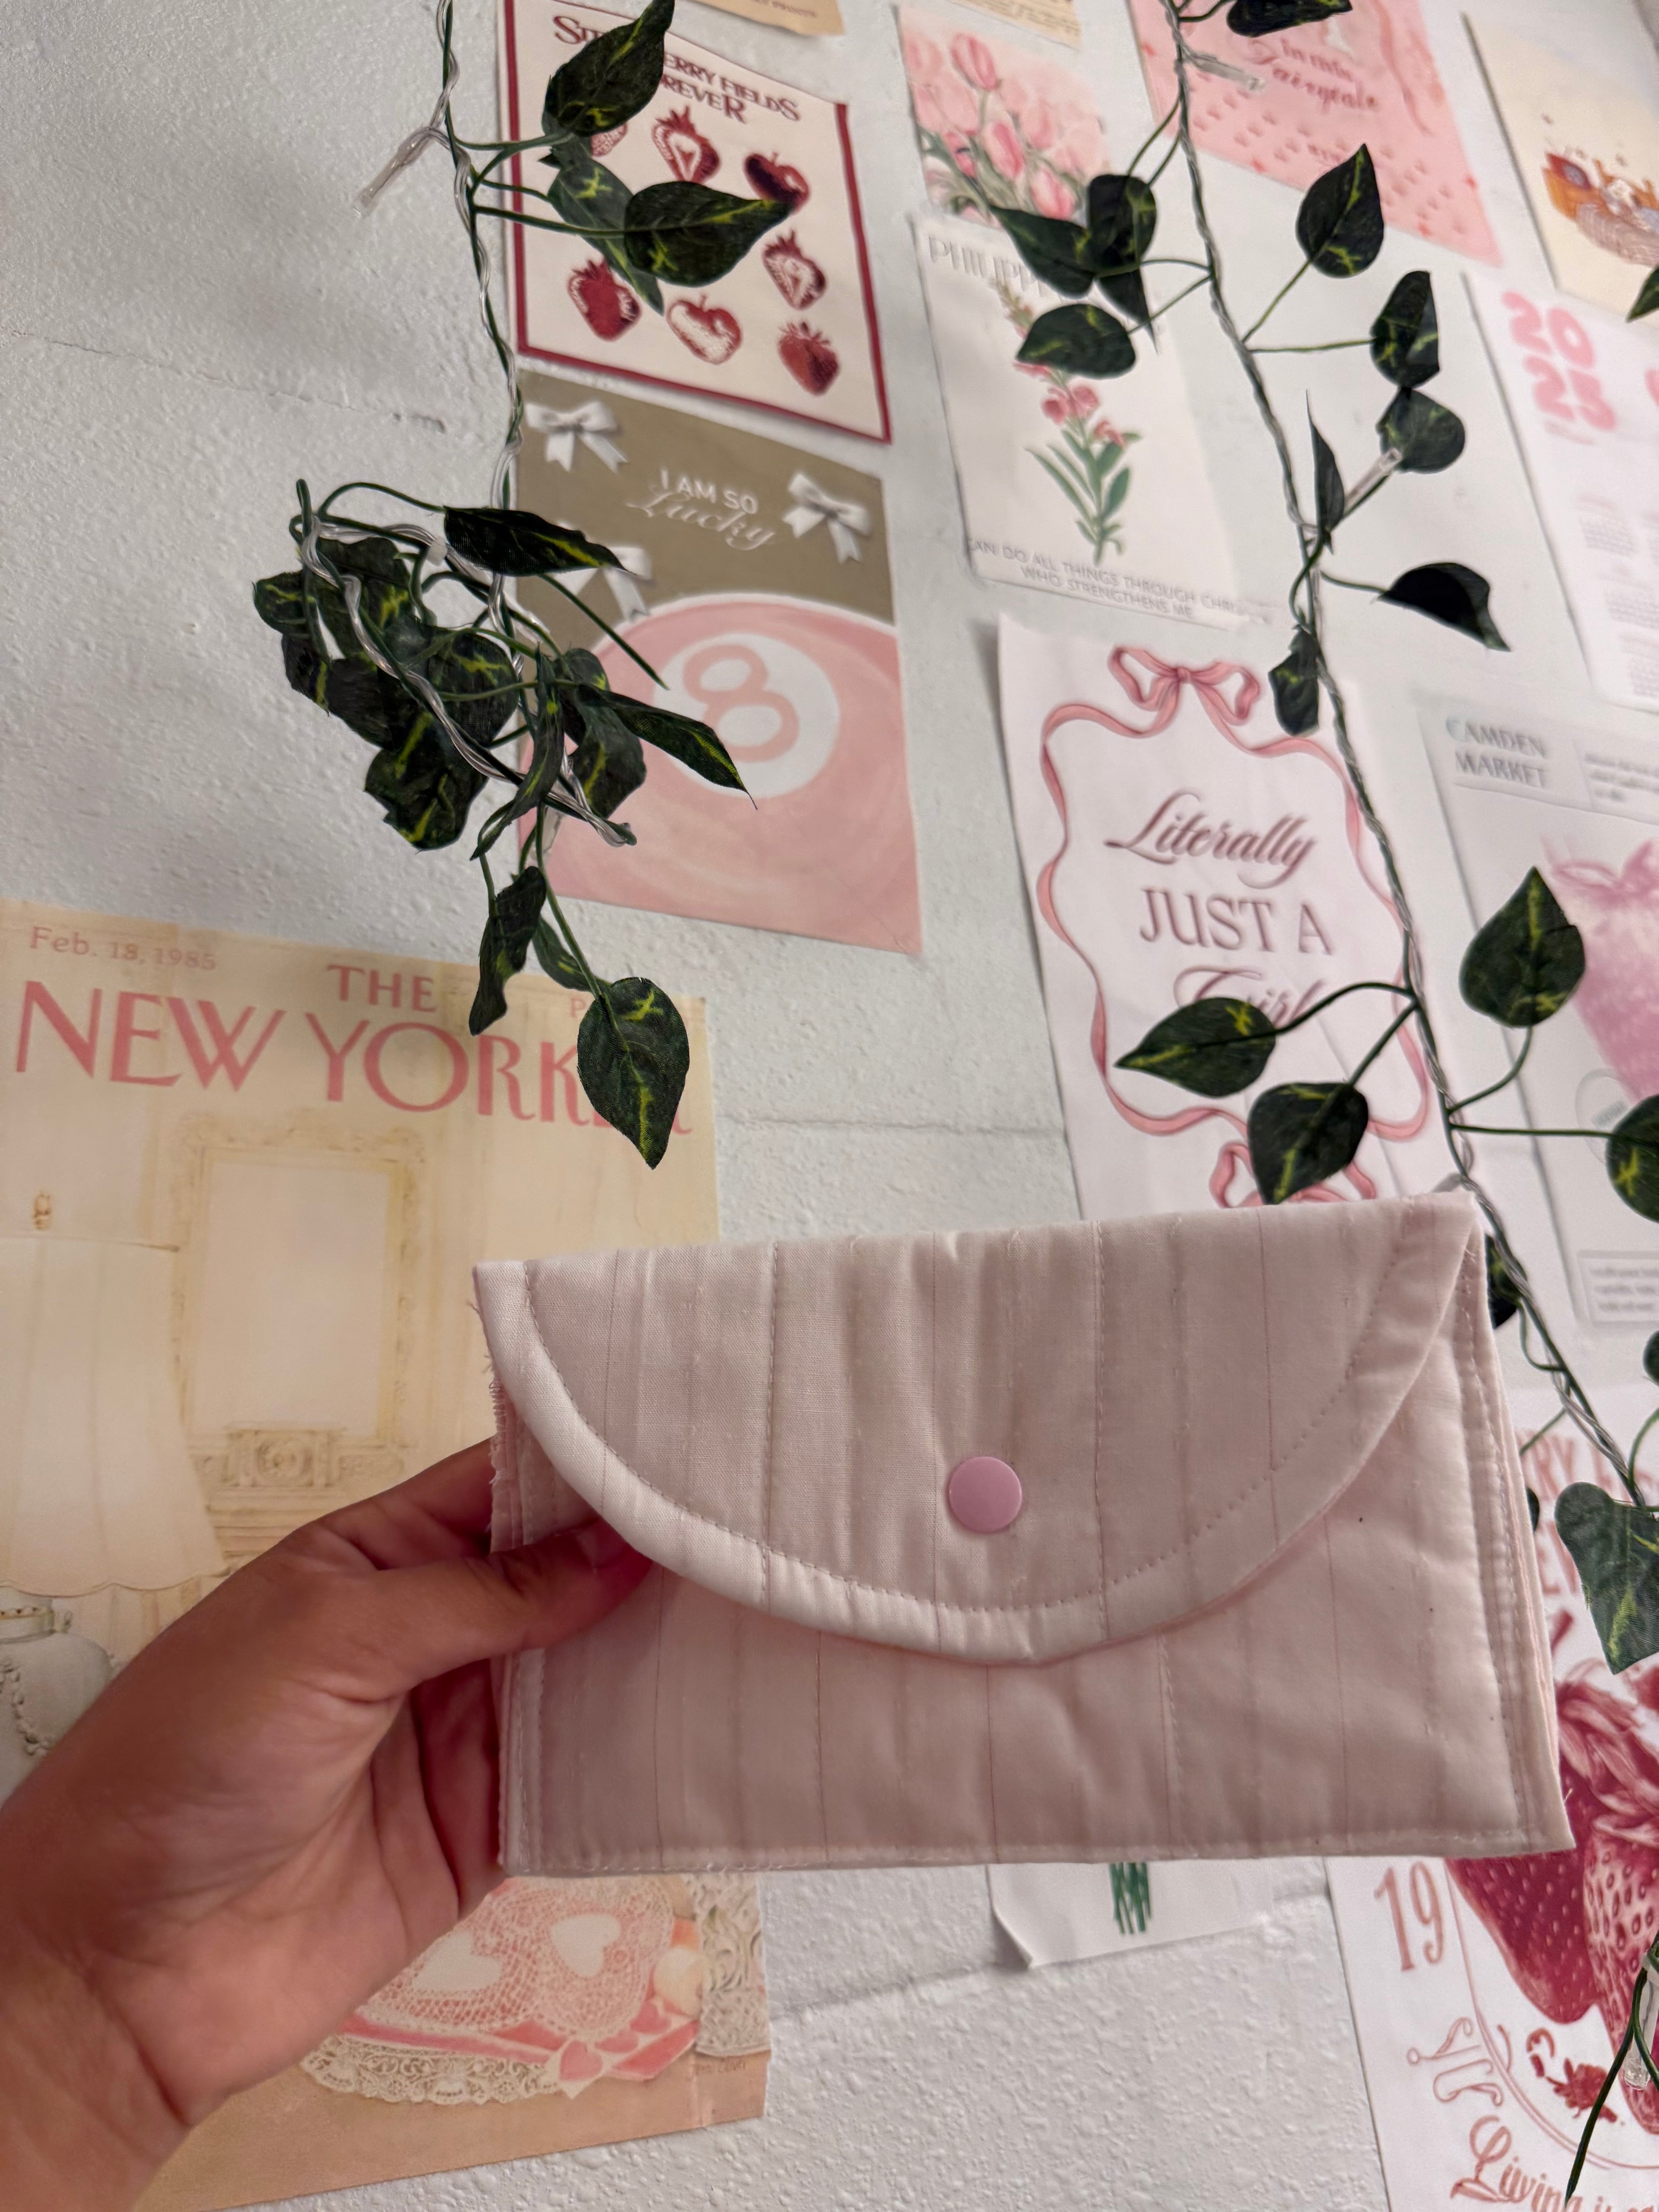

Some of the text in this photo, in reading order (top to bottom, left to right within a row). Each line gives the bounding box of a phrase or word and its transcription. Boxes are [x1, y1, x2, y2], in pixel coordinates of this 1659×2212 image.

[553, 16, 800, 122] STERRY FIELDS
[660, 73, 747, 124] REVER
[1501, 289, 1596, 369] 20
[625, 482, 776, 551] Lucky
[660, 467, 760, 515] I AM SO
[1001, 545, 1030, 563] DO
[1032, 553, 1057, 572] ALL
[1061, 561, 1121, 586] THINGS
[1122, 575, 1196, 605] THROUGH
[1020, 565, 1064, 588] WHO
[1066, 578, 1170, 614] STRENGTHENS
[682, 643, 801, 762] 8
[1453, 750, 1549, 789] MARKET
[1103, 787, 1316, 889] Literally
[29, 925, 97, 957] Feb.
[154, 947, 217, 971] 1985
[1139, 884, 1333, 955] JUST A
[327, 963, 437, 1013] THE
[16, 980, 692, 1135] NEW YORK
[1374, 1860, 1444, 1972] 19
